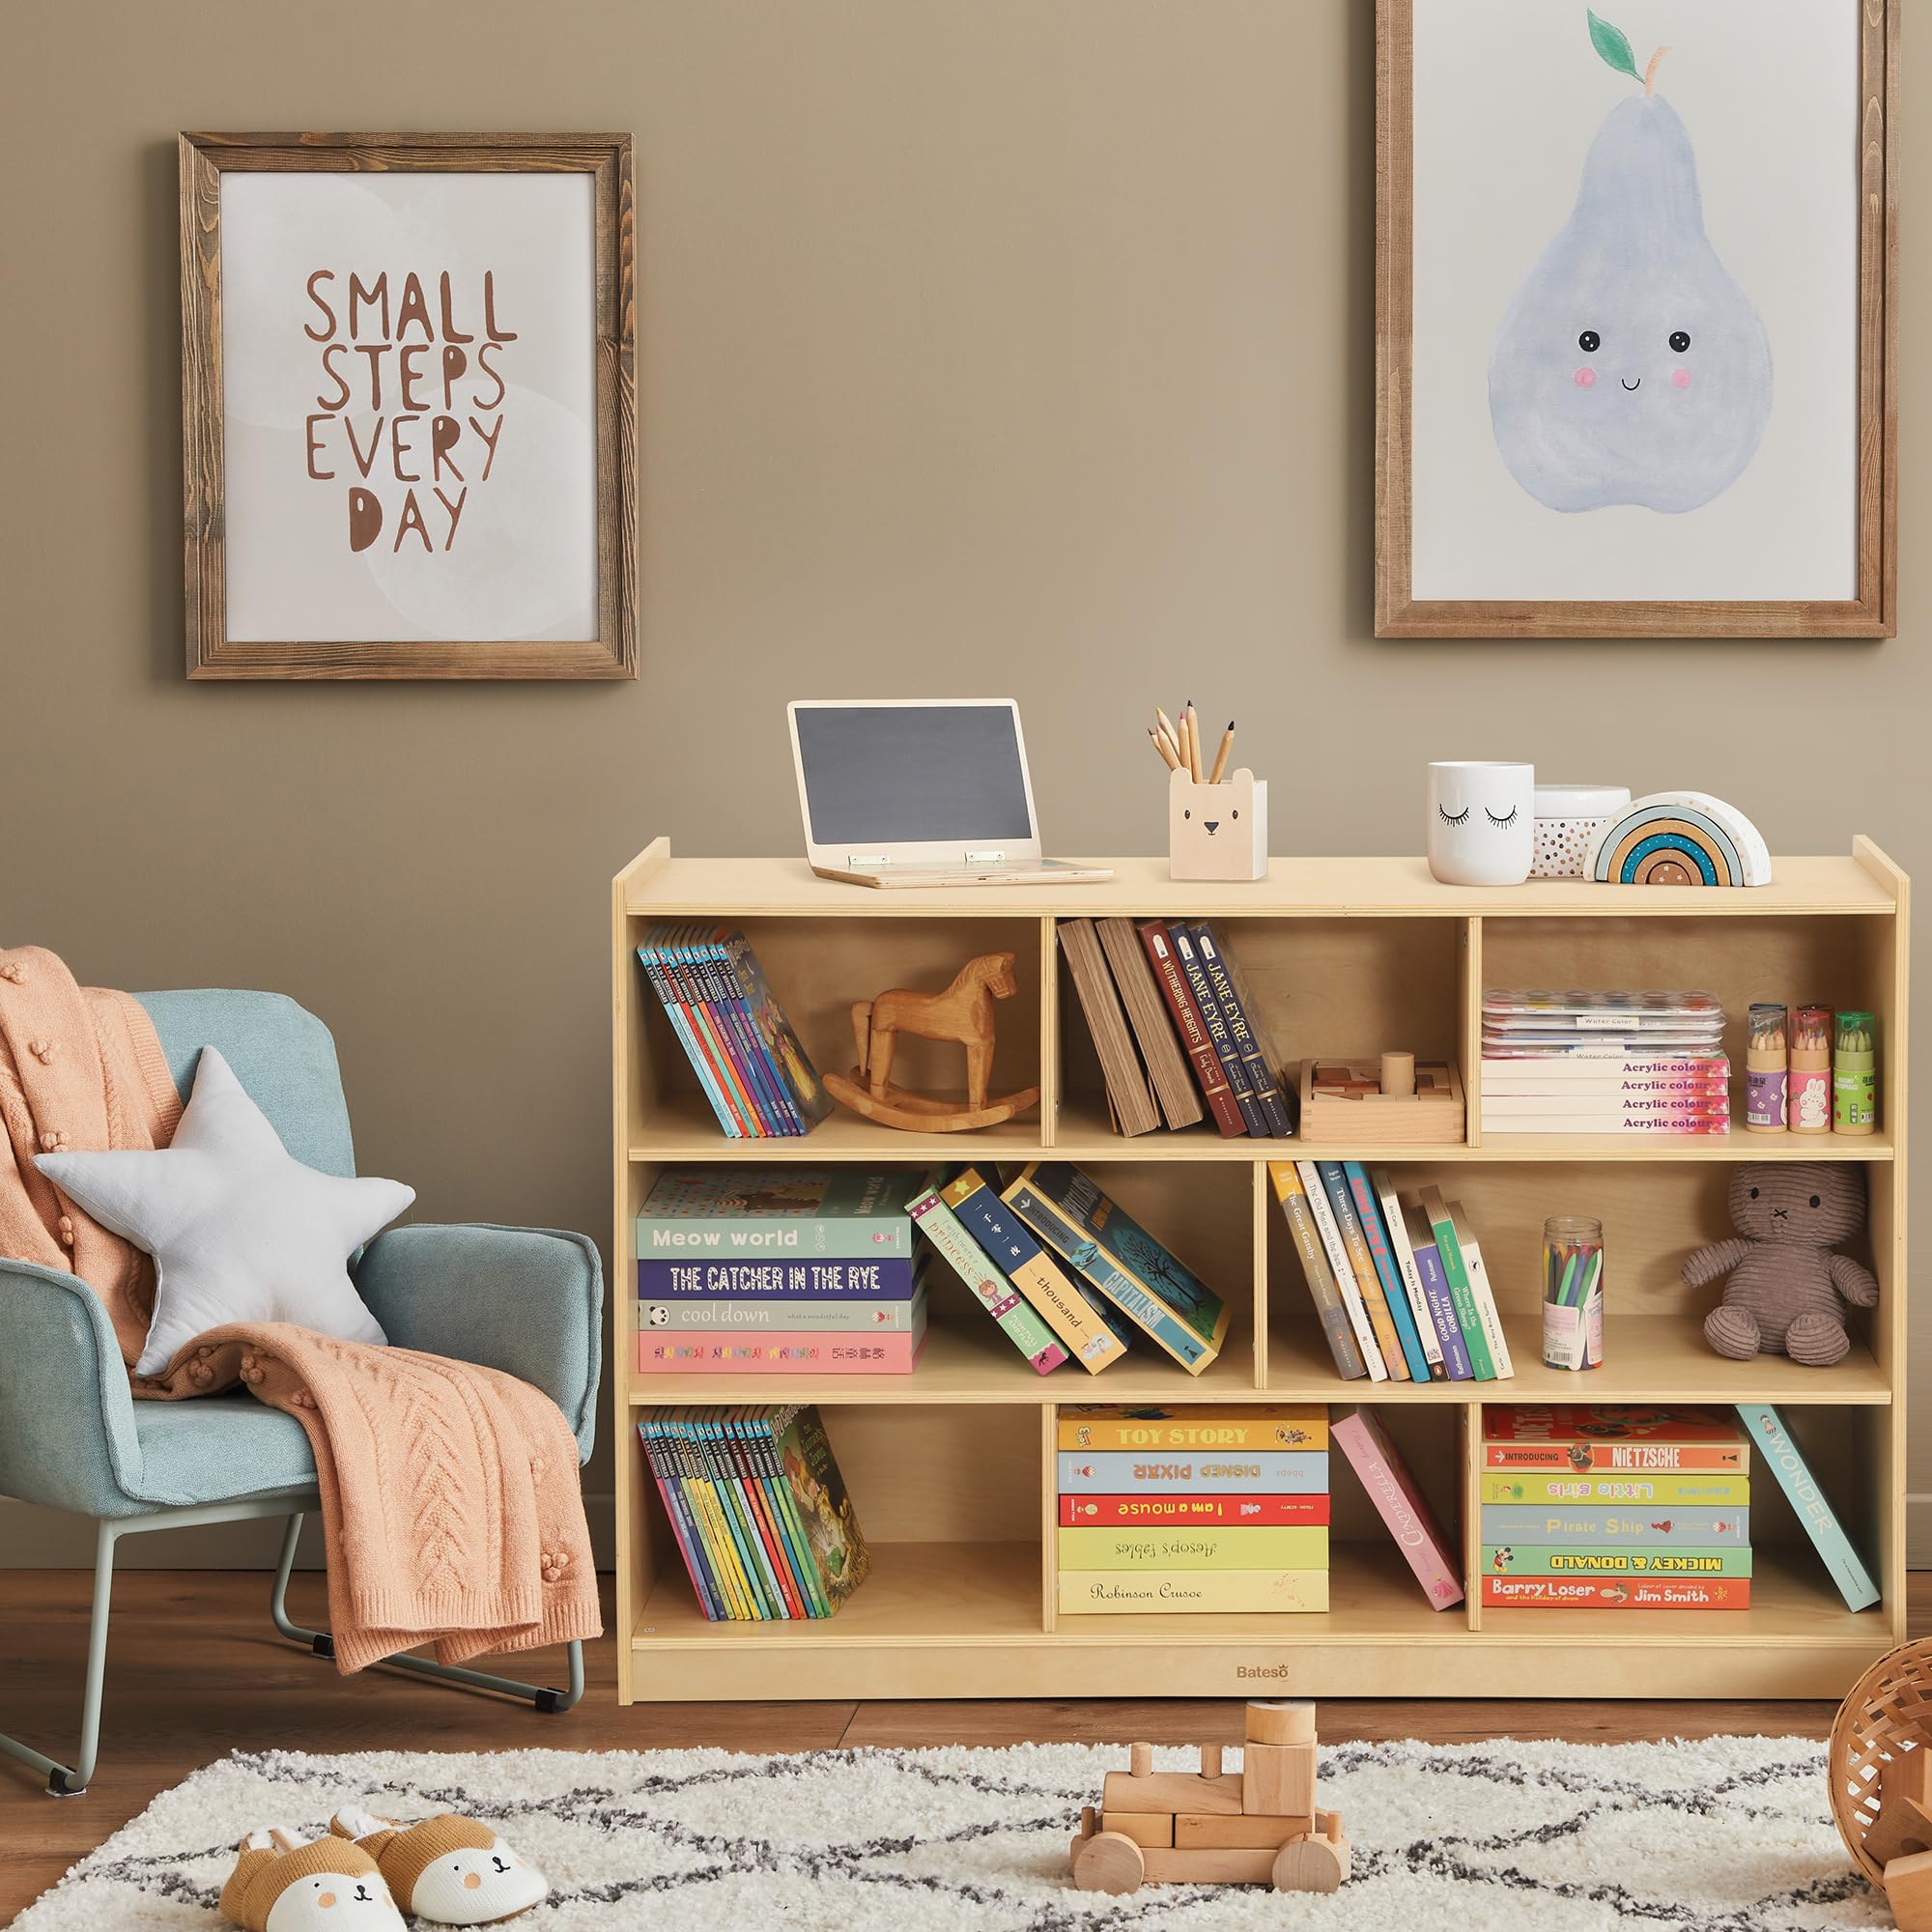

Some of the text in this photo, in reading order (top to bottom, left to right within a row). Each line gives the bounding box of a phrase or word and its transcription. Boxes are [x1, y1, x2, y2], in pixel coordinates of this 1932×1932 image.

[304, 270, 518, 343] SMALL
[317, 342, 505, 412] STEPS
[306, 413, 503, 482] EVERY
[348, 486, 468, 553] DAY
[1162, 959, 1202, 1043] WUTHERING HEIGHTS
[1185, 963, 1210, 1002] JANE
[1202, 1002, 1227, 1042] EYRE
[1208, 963, 1233, 1001] JANE
[1224, 1002, 1249, 1041] EYRE
[1623, 1064, 1667, 1073] Acrylic
[1622, 1081, 1665, 1091] Acrylic
[1623, 1099, 1711, 1109] Acrylic colour
[1624, 1119, 1712, 1128] Acrylic colour
[1350, 1178, 1374, 1215] Animal
[1027, 1205, 1069, 1243] INTRODUCING
[1287, 1189, 1315, 1259] The Great Gatsby
[1309, 1183, 1341, 1266] The Old Man and the Sea
[1336, 1187, 1364, 1262] Three Days To See
[653, 1230, 798, 1246] Meow world
[926, 1221, 972, 1274] princess
[670, 1265, 881, 1291] THE CATCHER IN THE RYE
[1427, 1259, 1437, 1282] Putnam
[1037, 1277, 1082, 1327] thousand
[1101, 1268, 1165, 1329] CAPITALISM
[1412, 1287, 1422, 1311] Monday
[1453, 1287, 1471, 1329] Green Sheep?
[1459, 1285, 1470, 1307] Where
[681, 1302, 771, 1322] cool down
[1440, 1295, 1457, 1333] GORILLA
[1436, 1317, 1449, 1341] GOOD
[1452, 1345, 1464, 1375] Rathmann
[1117, 1429, 1248, 1444] TOY STORY
[1505, 1447, 1680, 1467] INTRODUCING NIETZSCHE
[1132, 1463, 1261, 1480] DISNEY PIXAR
[1770, 1433, 1832, 1534] WONDER
[1547, 1482, 1653, 1499] Little girls
[1117, 1502, 1223, 1516] I am a mouse
[1368, 1462, 1423, 1546] CINDERELLA
[1547, 1519, 1644, 1535] Pirate Ship
[1115, 1540, 1216, 1558] Aesop's fables
[1550, 1555, 1722, 1571] MICKEY & DONALD
[1090, 1582, 1203, 1600] Robinson Crusoe
[1492, 1578, 1595, 1596] Barry Loser
[1634, 1589, 1709, 1602] Jim Smith
[1236, 1664, 1289, 1678] Bateso
